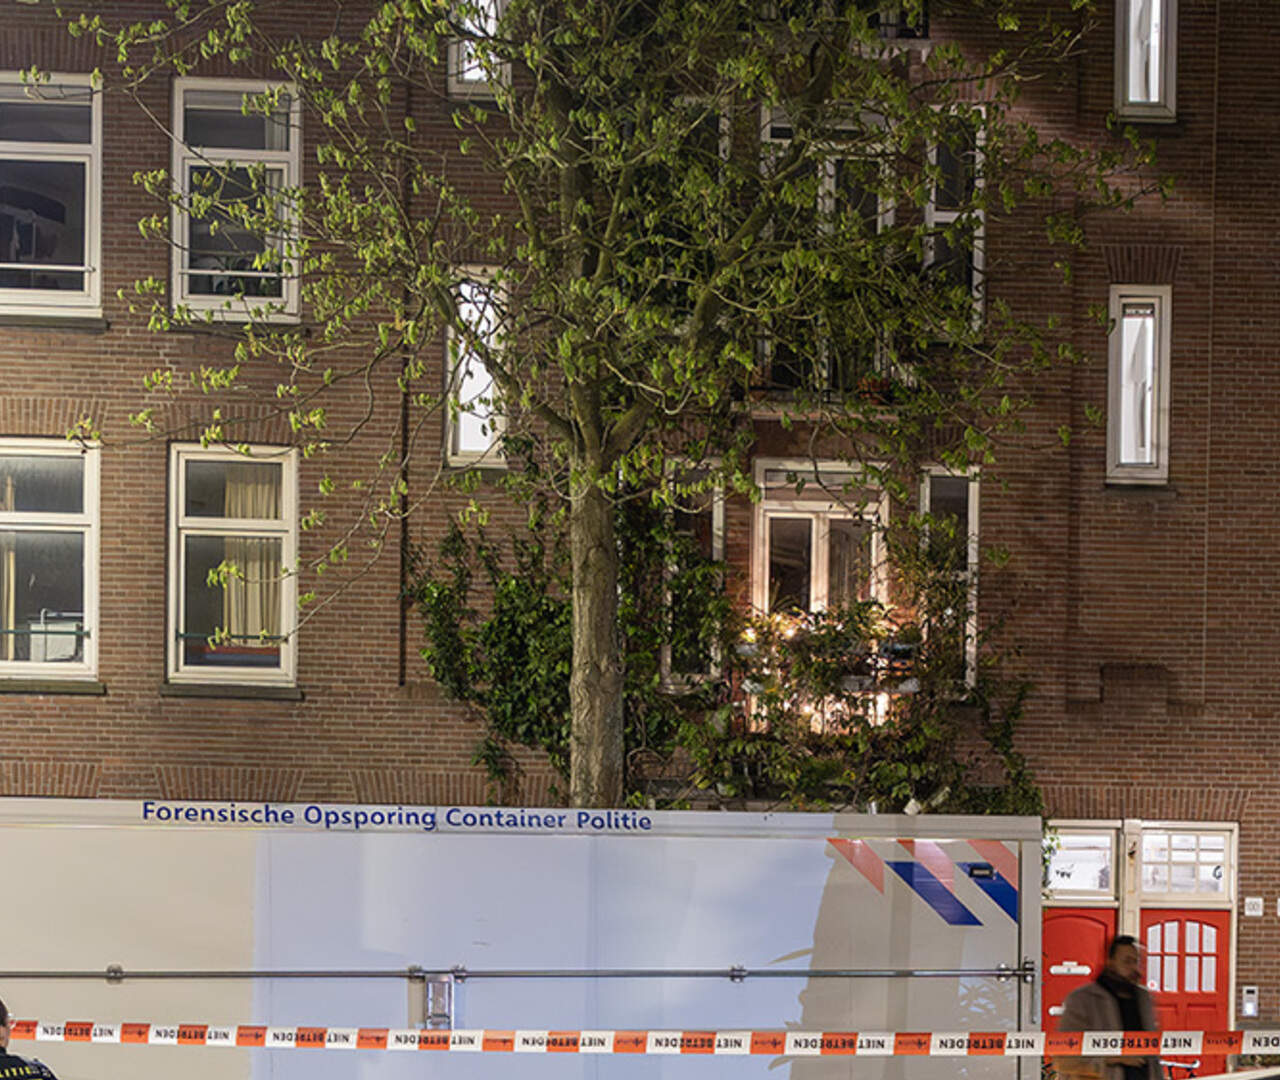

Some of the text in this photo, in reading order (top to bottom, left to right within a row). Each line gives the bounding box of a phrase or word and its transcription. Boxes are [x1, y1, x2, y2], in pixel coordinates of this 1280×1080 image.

[142, 802, 652, 831] Forensische Opsporing Container Politie
[451, 1036, 475, 1045] NIET
[581, 1037, 606, 1047] NIET
[716, 1039, 743, 1048] NIET
[793, 1038, 855, 1049] BETREDEN
[858, 1038, 885, 1049] NIET
[939, 1038, 1003, 1049] BETREDEN
[1007, 1038, 1035, 1049] NIET
[1092, 1038, 1192, 1049] NIET BETREDEN
